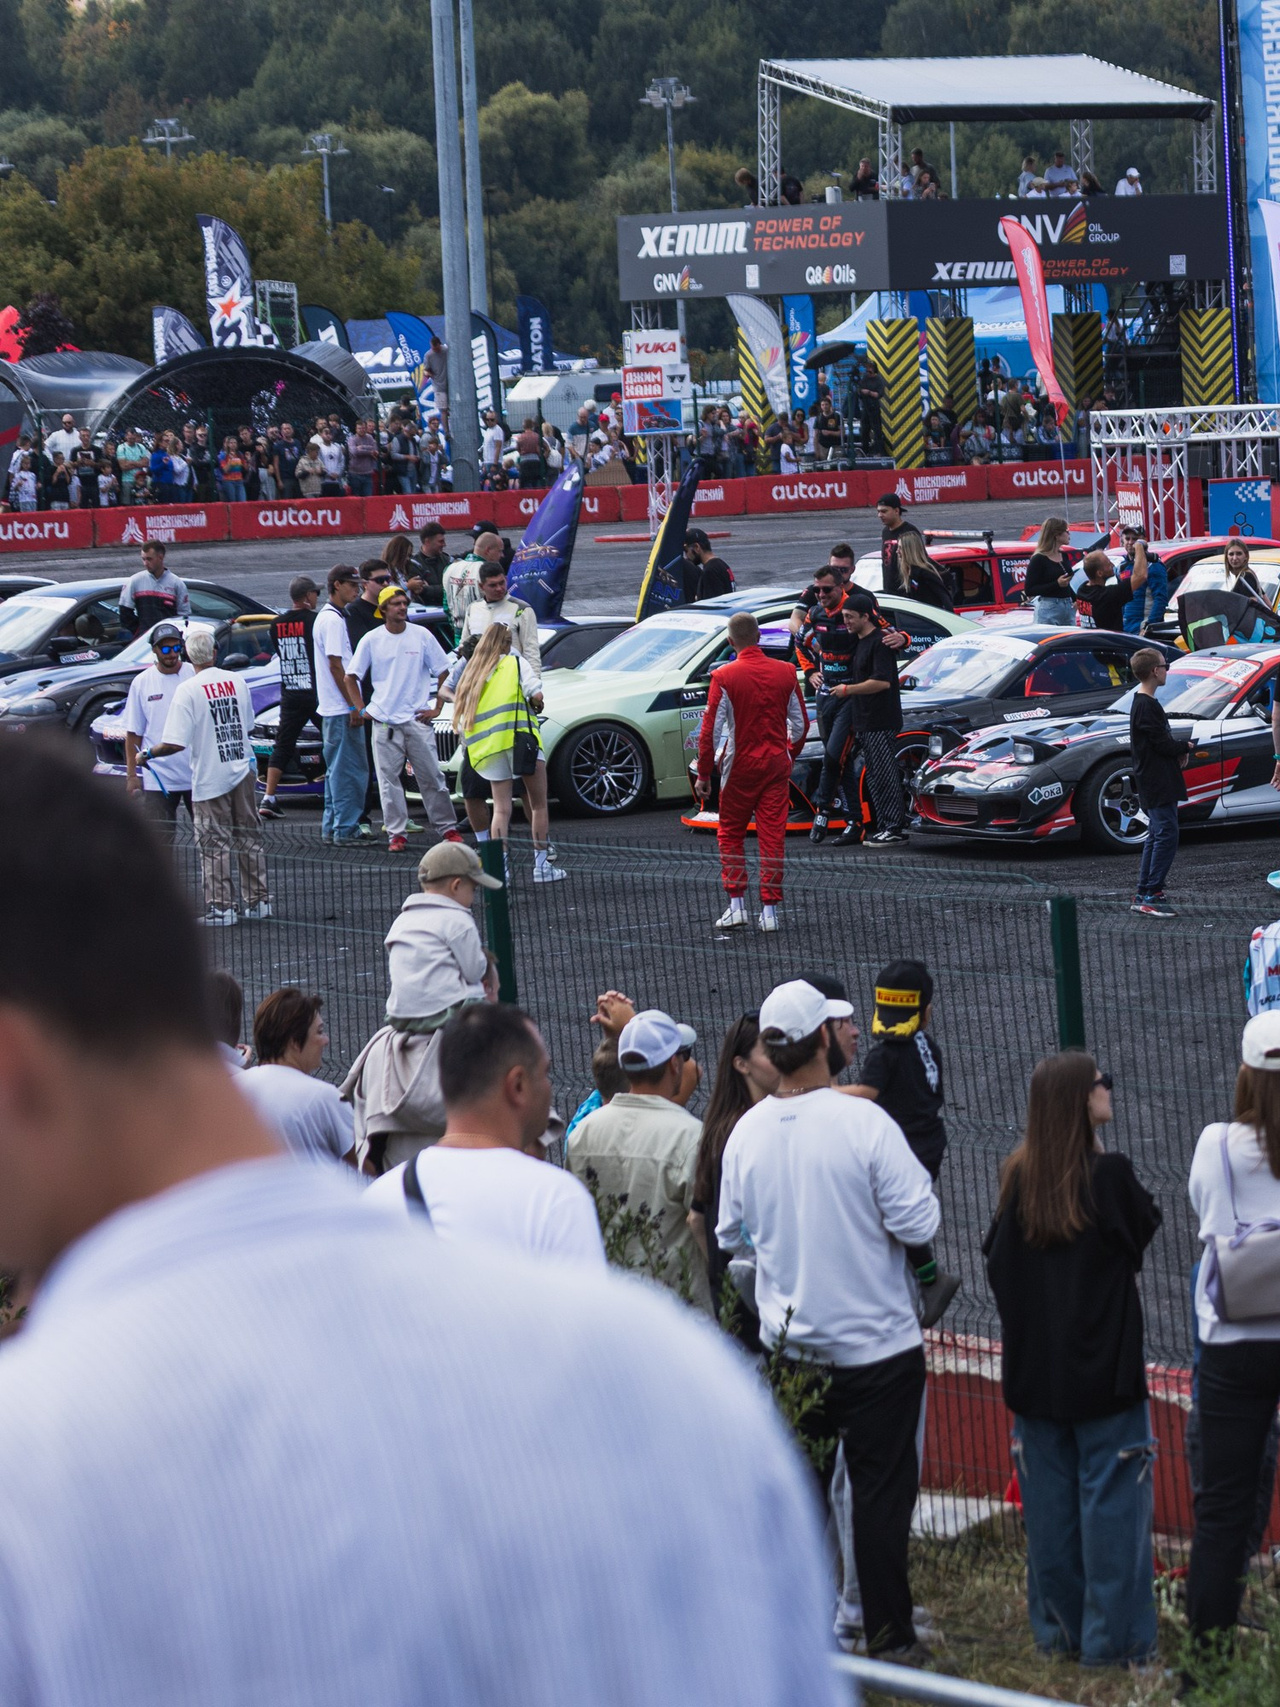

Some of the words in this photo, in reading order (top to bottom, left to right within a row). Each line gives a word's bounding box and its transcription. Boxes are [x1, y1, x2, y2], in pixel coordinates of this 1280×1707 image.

[755, 219, 815, 235] POWER
[819, 215, 843, 231] OF
[1088, 222, 1104, 233] OIL
[637, 221, 748, 259] XENUM
[752, 231, 866, 251] TECHNOLOGY
[1088, 232, 1121, 243] GROUP
[1091, 257, 1111, 268] OF
[805, 266, 823, 285] Q8
[833, 262, 857, 284] Oils
[1043, 267, 1129, 278] ECHNOLOGY
[653, 272, 681, 293] GNV
[635, 341, 677, 354] YUKA
[625, 371, 662, 385] ДЖИМ
[625, 384, 662, 397] ХАНА
[914, 471, 967, 488] МОСКОВСКИЙ
[1012, 468, 1085, 487] auto.ru
[772, 481, 848, 501] auto.ru
[914, 488, 940, 501] СПОРТ
[1118, 491, 1142, 508] ДЖИМ
[412, 498, 471, 516] МОСКОВСКИЙ
[258, 508, 341, 527] auto.ru
[1119, 510, 1143, 526] ХАНА
[0, 520, 69, 541] uto.ru
[277, 620, 305, 638] TEAM
[60, 653, 91, 664] DRYDRY
[279, 643, 308, 660] YUKA
[202, 681, 237, 700] TEAM
[210, 706, 242, 725] YUKA
[1005, 710, 1039, 723] DRYDRY
[878, 990, 917, 1004] PIRELLI
